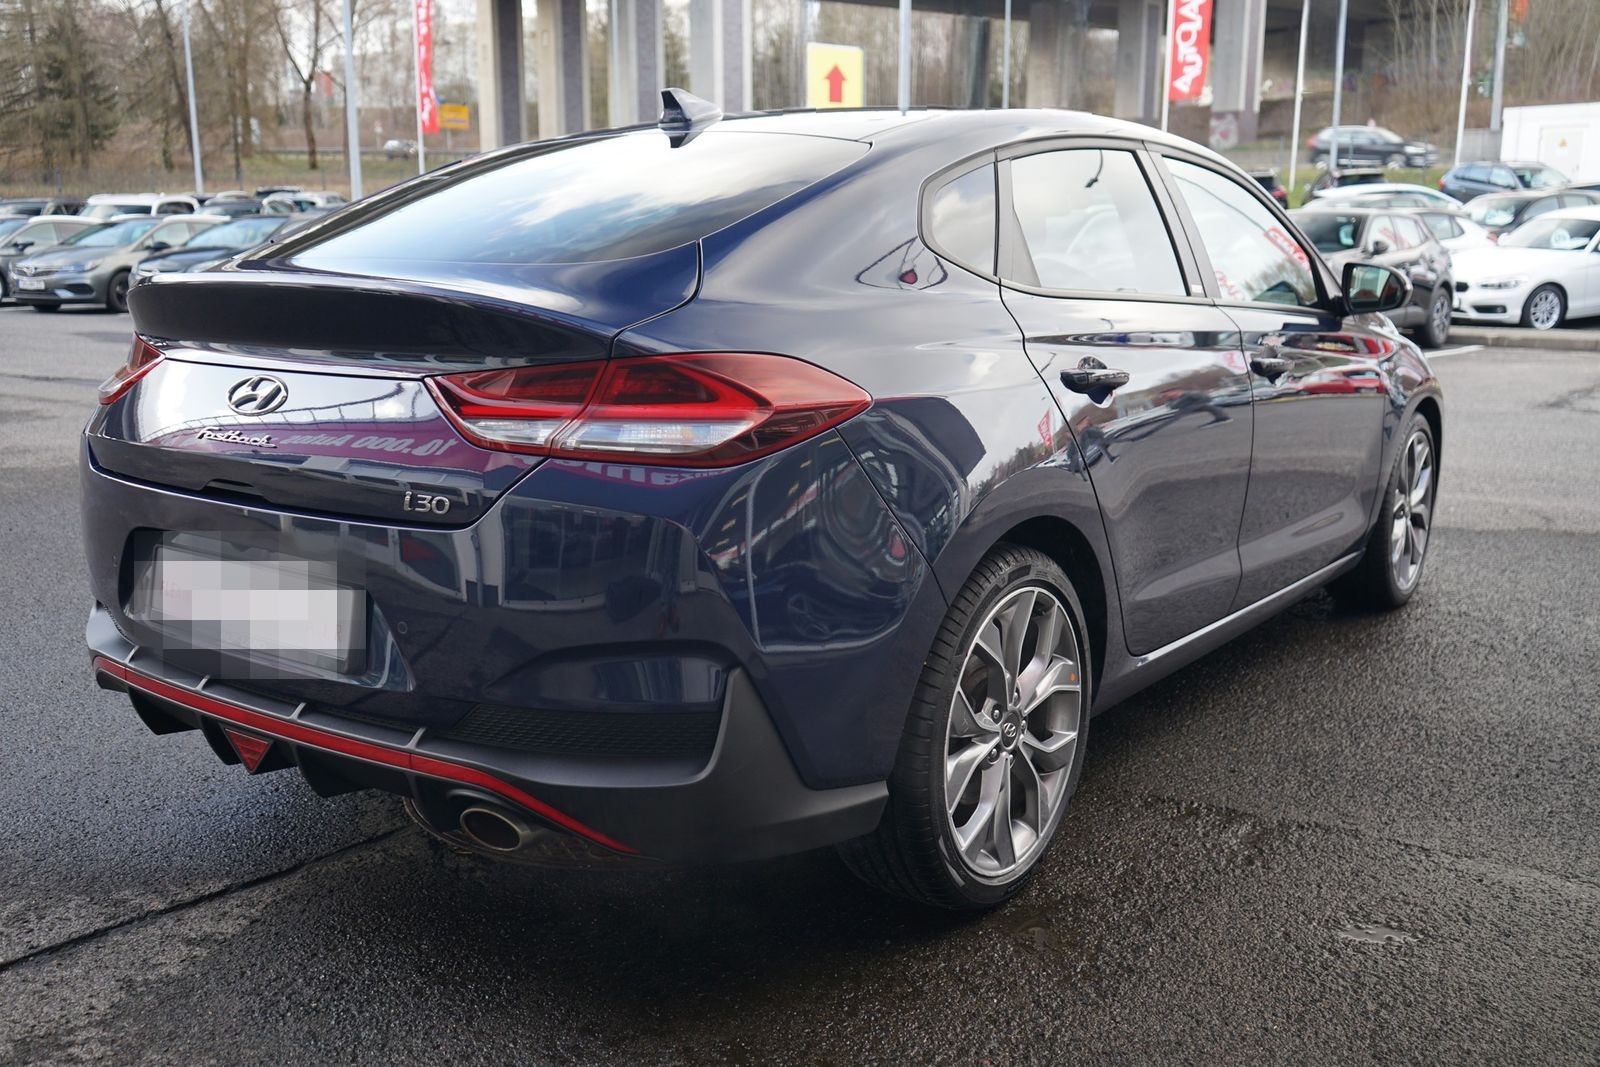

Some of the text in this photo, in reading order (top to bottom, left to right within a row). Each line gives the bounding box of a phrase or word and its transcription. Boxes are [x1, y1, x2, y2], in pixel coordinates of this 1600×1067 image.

[1172, 0, 1207, 94] AUTOLA
[197, 426, 278, 448] Fastback
[404, 491, 450, 515] i30
